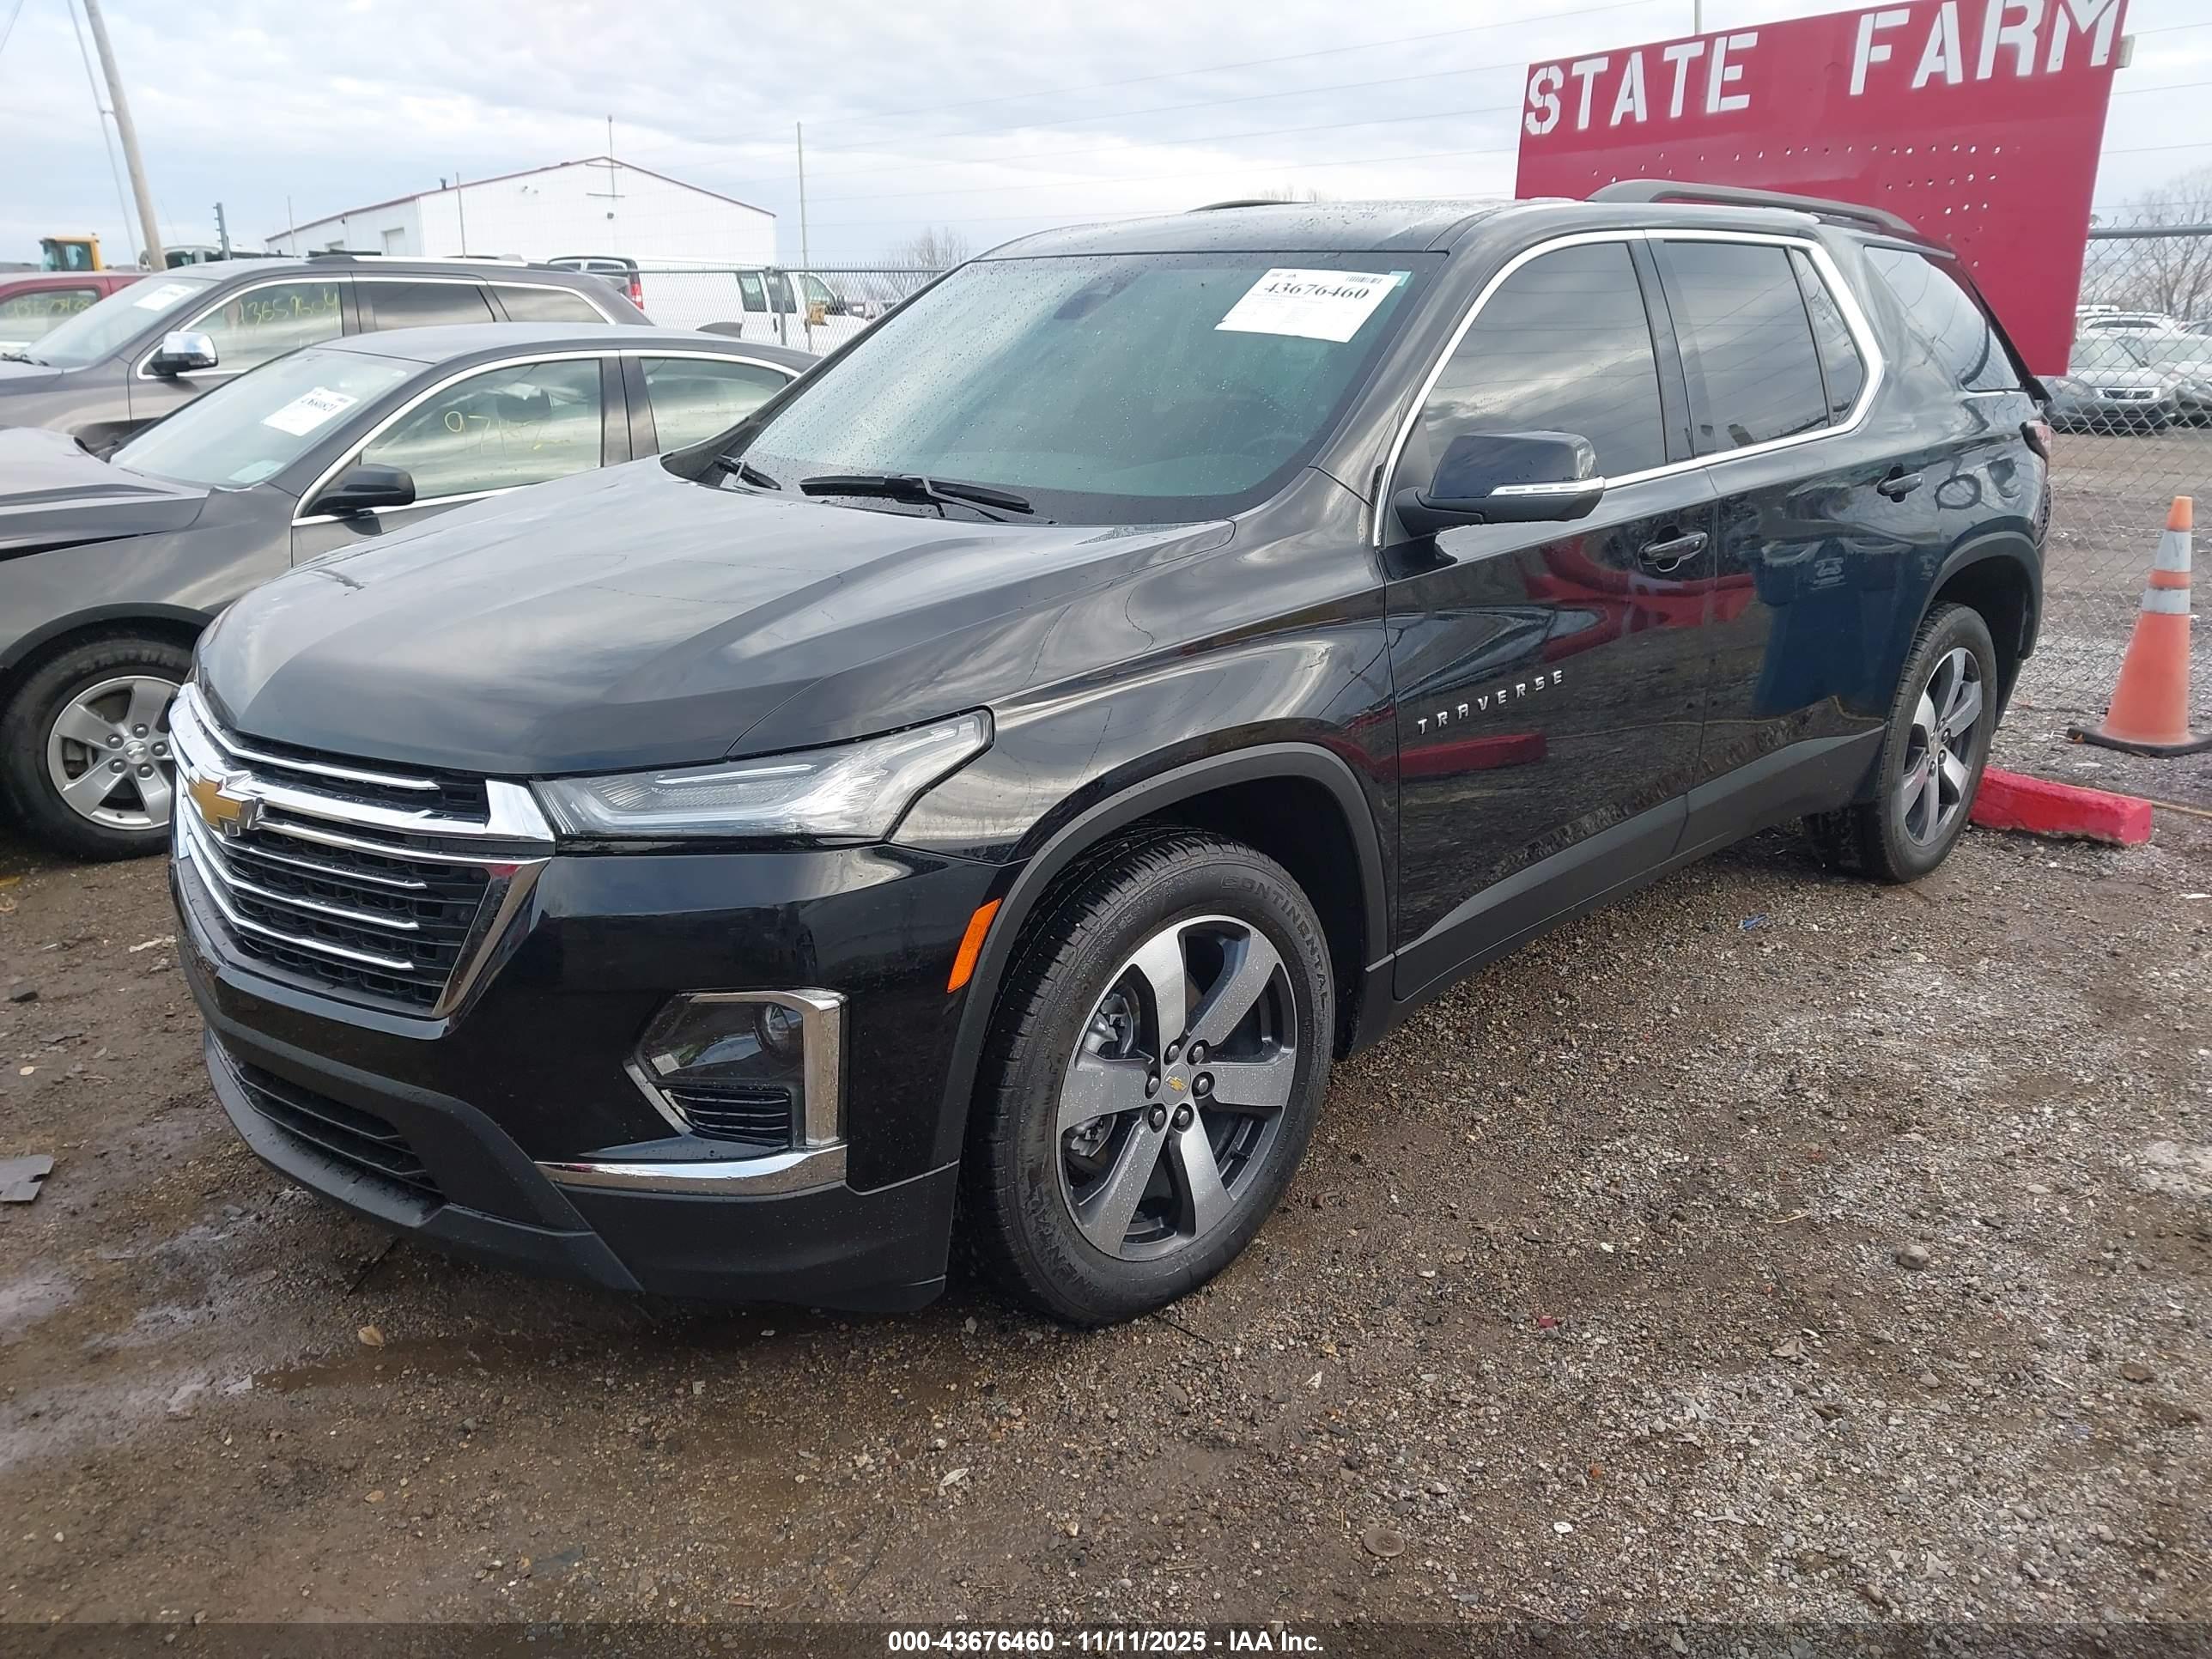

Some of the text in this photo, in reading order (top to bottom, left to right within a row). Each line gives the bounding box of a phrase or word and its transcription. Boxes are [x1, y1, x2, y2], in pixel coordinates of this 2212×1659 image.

[1524, 0, 2122, 137] STATE FARM
[1263, 282, 1370, 300] 43676460
[1417, 669, 1564, 736] TRAVERSE
